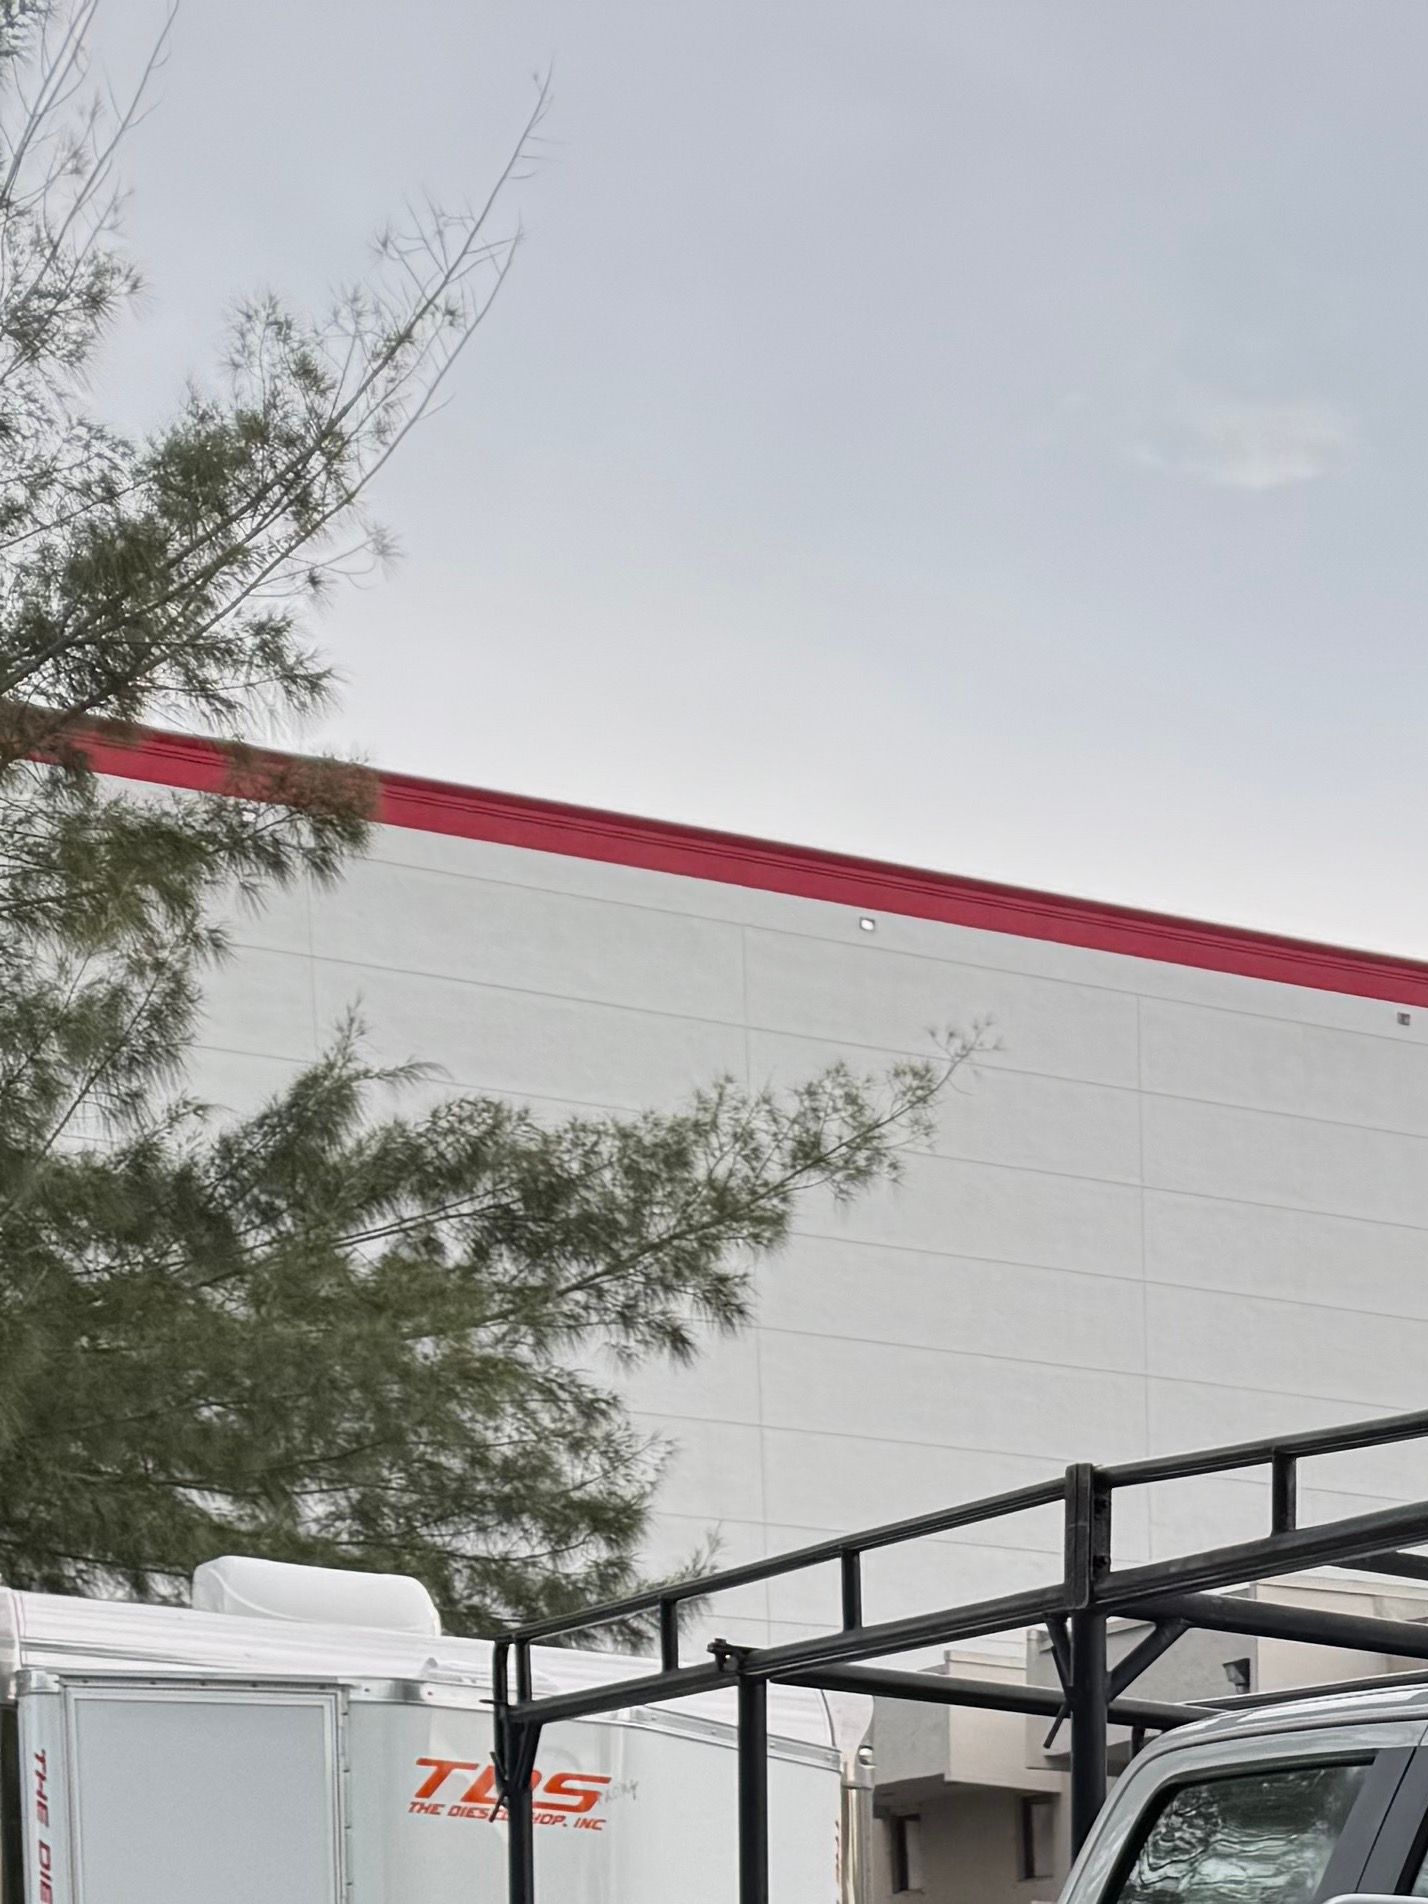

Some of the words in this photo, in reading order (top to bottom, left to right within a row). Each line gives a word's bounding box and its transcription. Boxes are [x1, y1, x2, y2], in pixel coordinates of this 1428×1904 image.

[34, 1748, 50, 1828] THE
[408, 1801, 445, 1816] THE
[573, 1816, 608, 1831] INC
